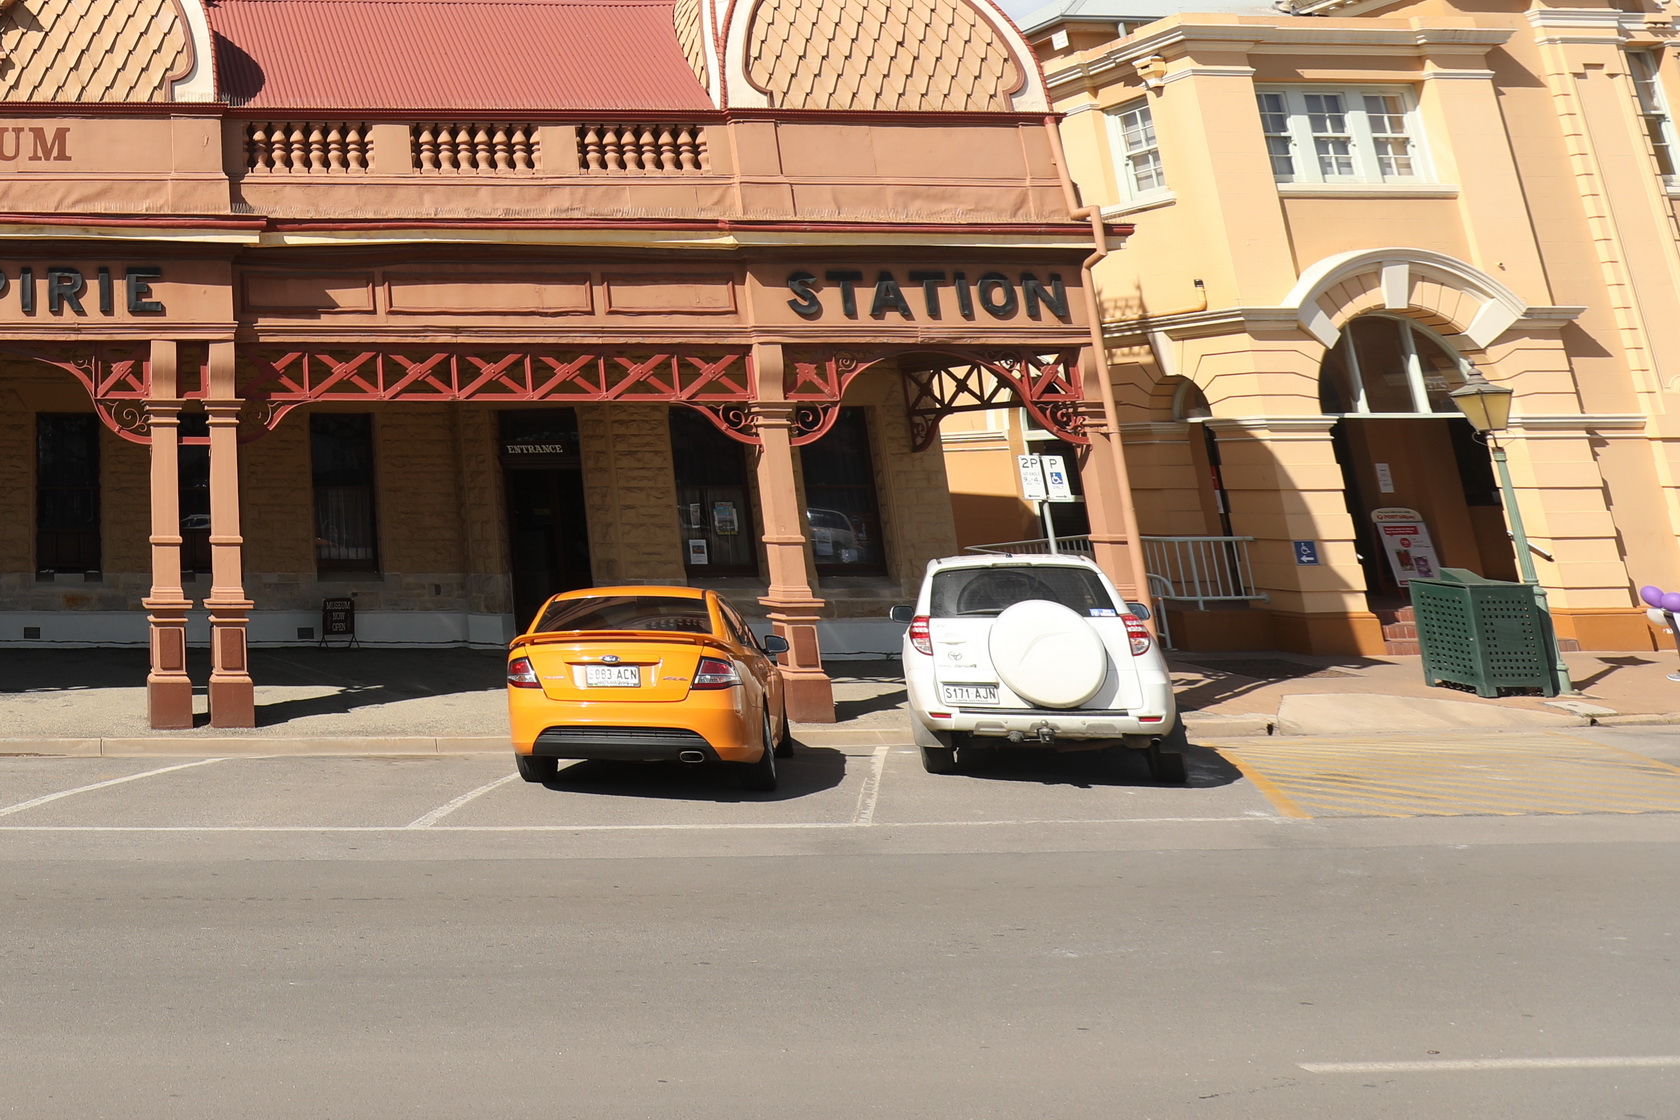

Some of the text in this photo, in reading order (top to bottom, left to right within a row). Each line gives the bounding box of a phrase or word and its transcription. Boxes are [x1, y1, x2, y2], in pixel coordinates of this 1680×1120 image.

[786, 270, 1069, 318] STATION
[506, 444, 564, 454] ENTRANCE
[1021, 457, 1038, 468] 2P
[1049, 458, 1058, 468] P
[326, 601, 351, 609] MUSEUM
[332, 612, 345, 620] NOW
[332, 623, 346, 631] OPEN
